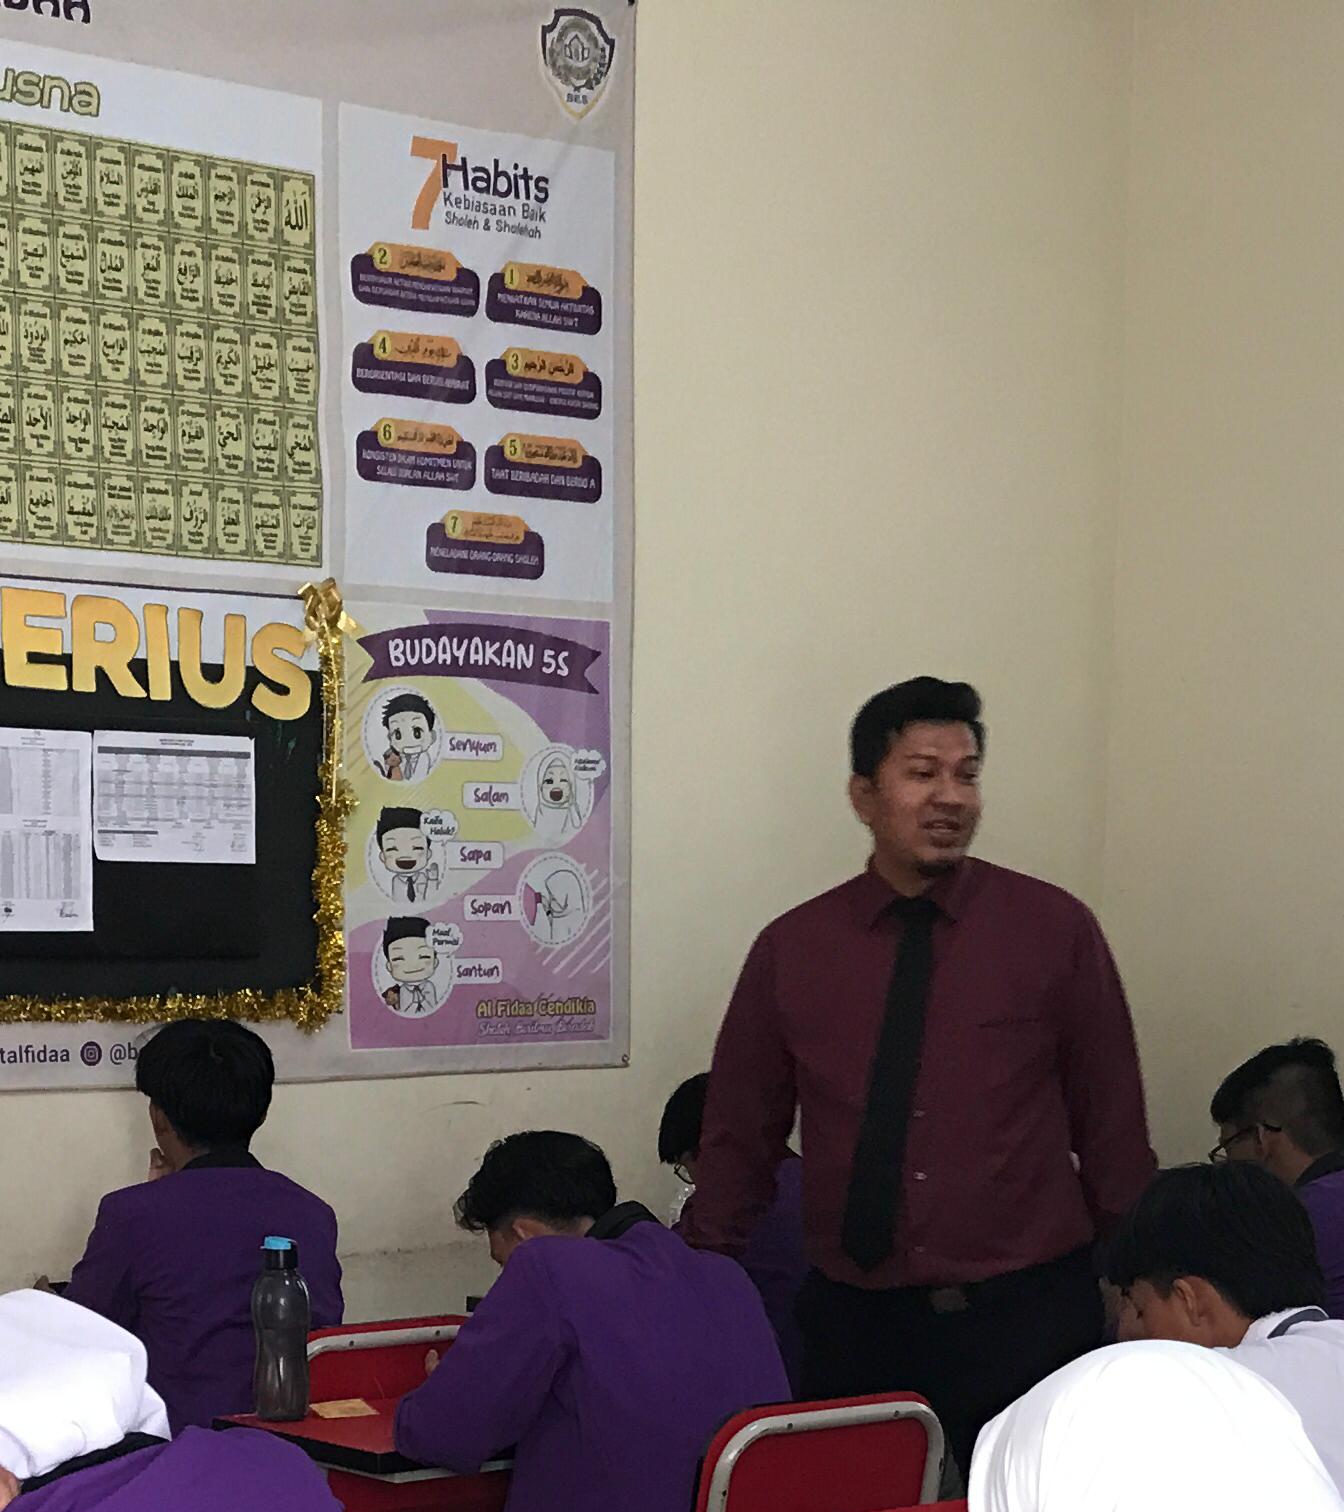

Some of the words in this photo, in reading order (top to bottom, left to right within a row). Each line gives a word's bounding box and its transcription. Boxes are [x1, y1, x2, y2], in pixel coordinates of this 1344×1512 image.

[410, 136, 458, 230] 7
[442, 154, 549, 203] Habits
[443, 192, 516, 217] Kebiasaan
[522, 203, 547, 223] Baik
[445, 211, 479, 230] Sholeh
[483, 218, 491, 232] &
[378, 248, 387, 265] 2
[378, 337, 387, 354] 4
[511, 355, 519, 371] 3
[382, 423, 392, 441] 6
[509, 440, 518, 455] 5
[387, 636, 534, 670] BUDAYAKAN
[542, 648, 570, 677] 5S
[476, 1000, 493, 1019] Al
[496, 998, 535, 1018] Fidaa
